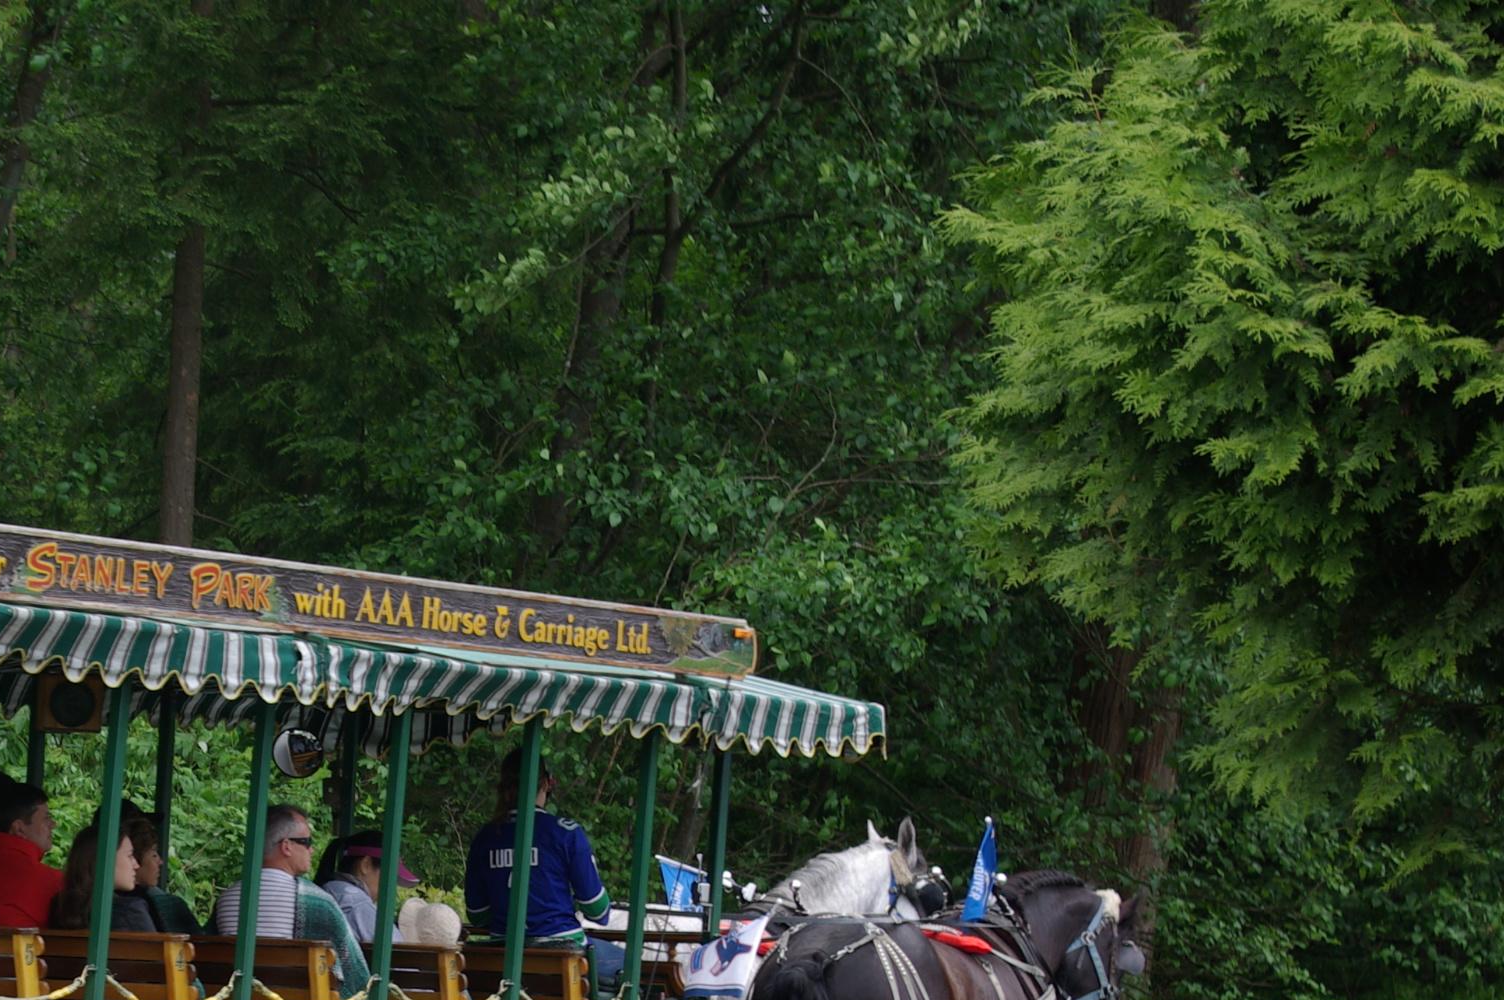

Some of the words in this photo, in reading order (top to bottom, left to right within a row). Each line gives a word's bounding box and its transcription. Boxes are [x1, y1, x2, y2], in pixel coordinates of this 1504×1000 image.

[26, 543, 173, 599] STANLEY
[190, 562, 275, 612] PARK
[294, 582, 346, 619] with
[355, 585, 414, 628] AAA
[422, 596, 487, 637] Horse
[495, 605, 511, 639] &
[518, 608, 610, 656] Carriage
[616, 619, 652, 654] Ltd.
[24, 943, 34, 966] 5
[175, 948, 185, 972] 4
